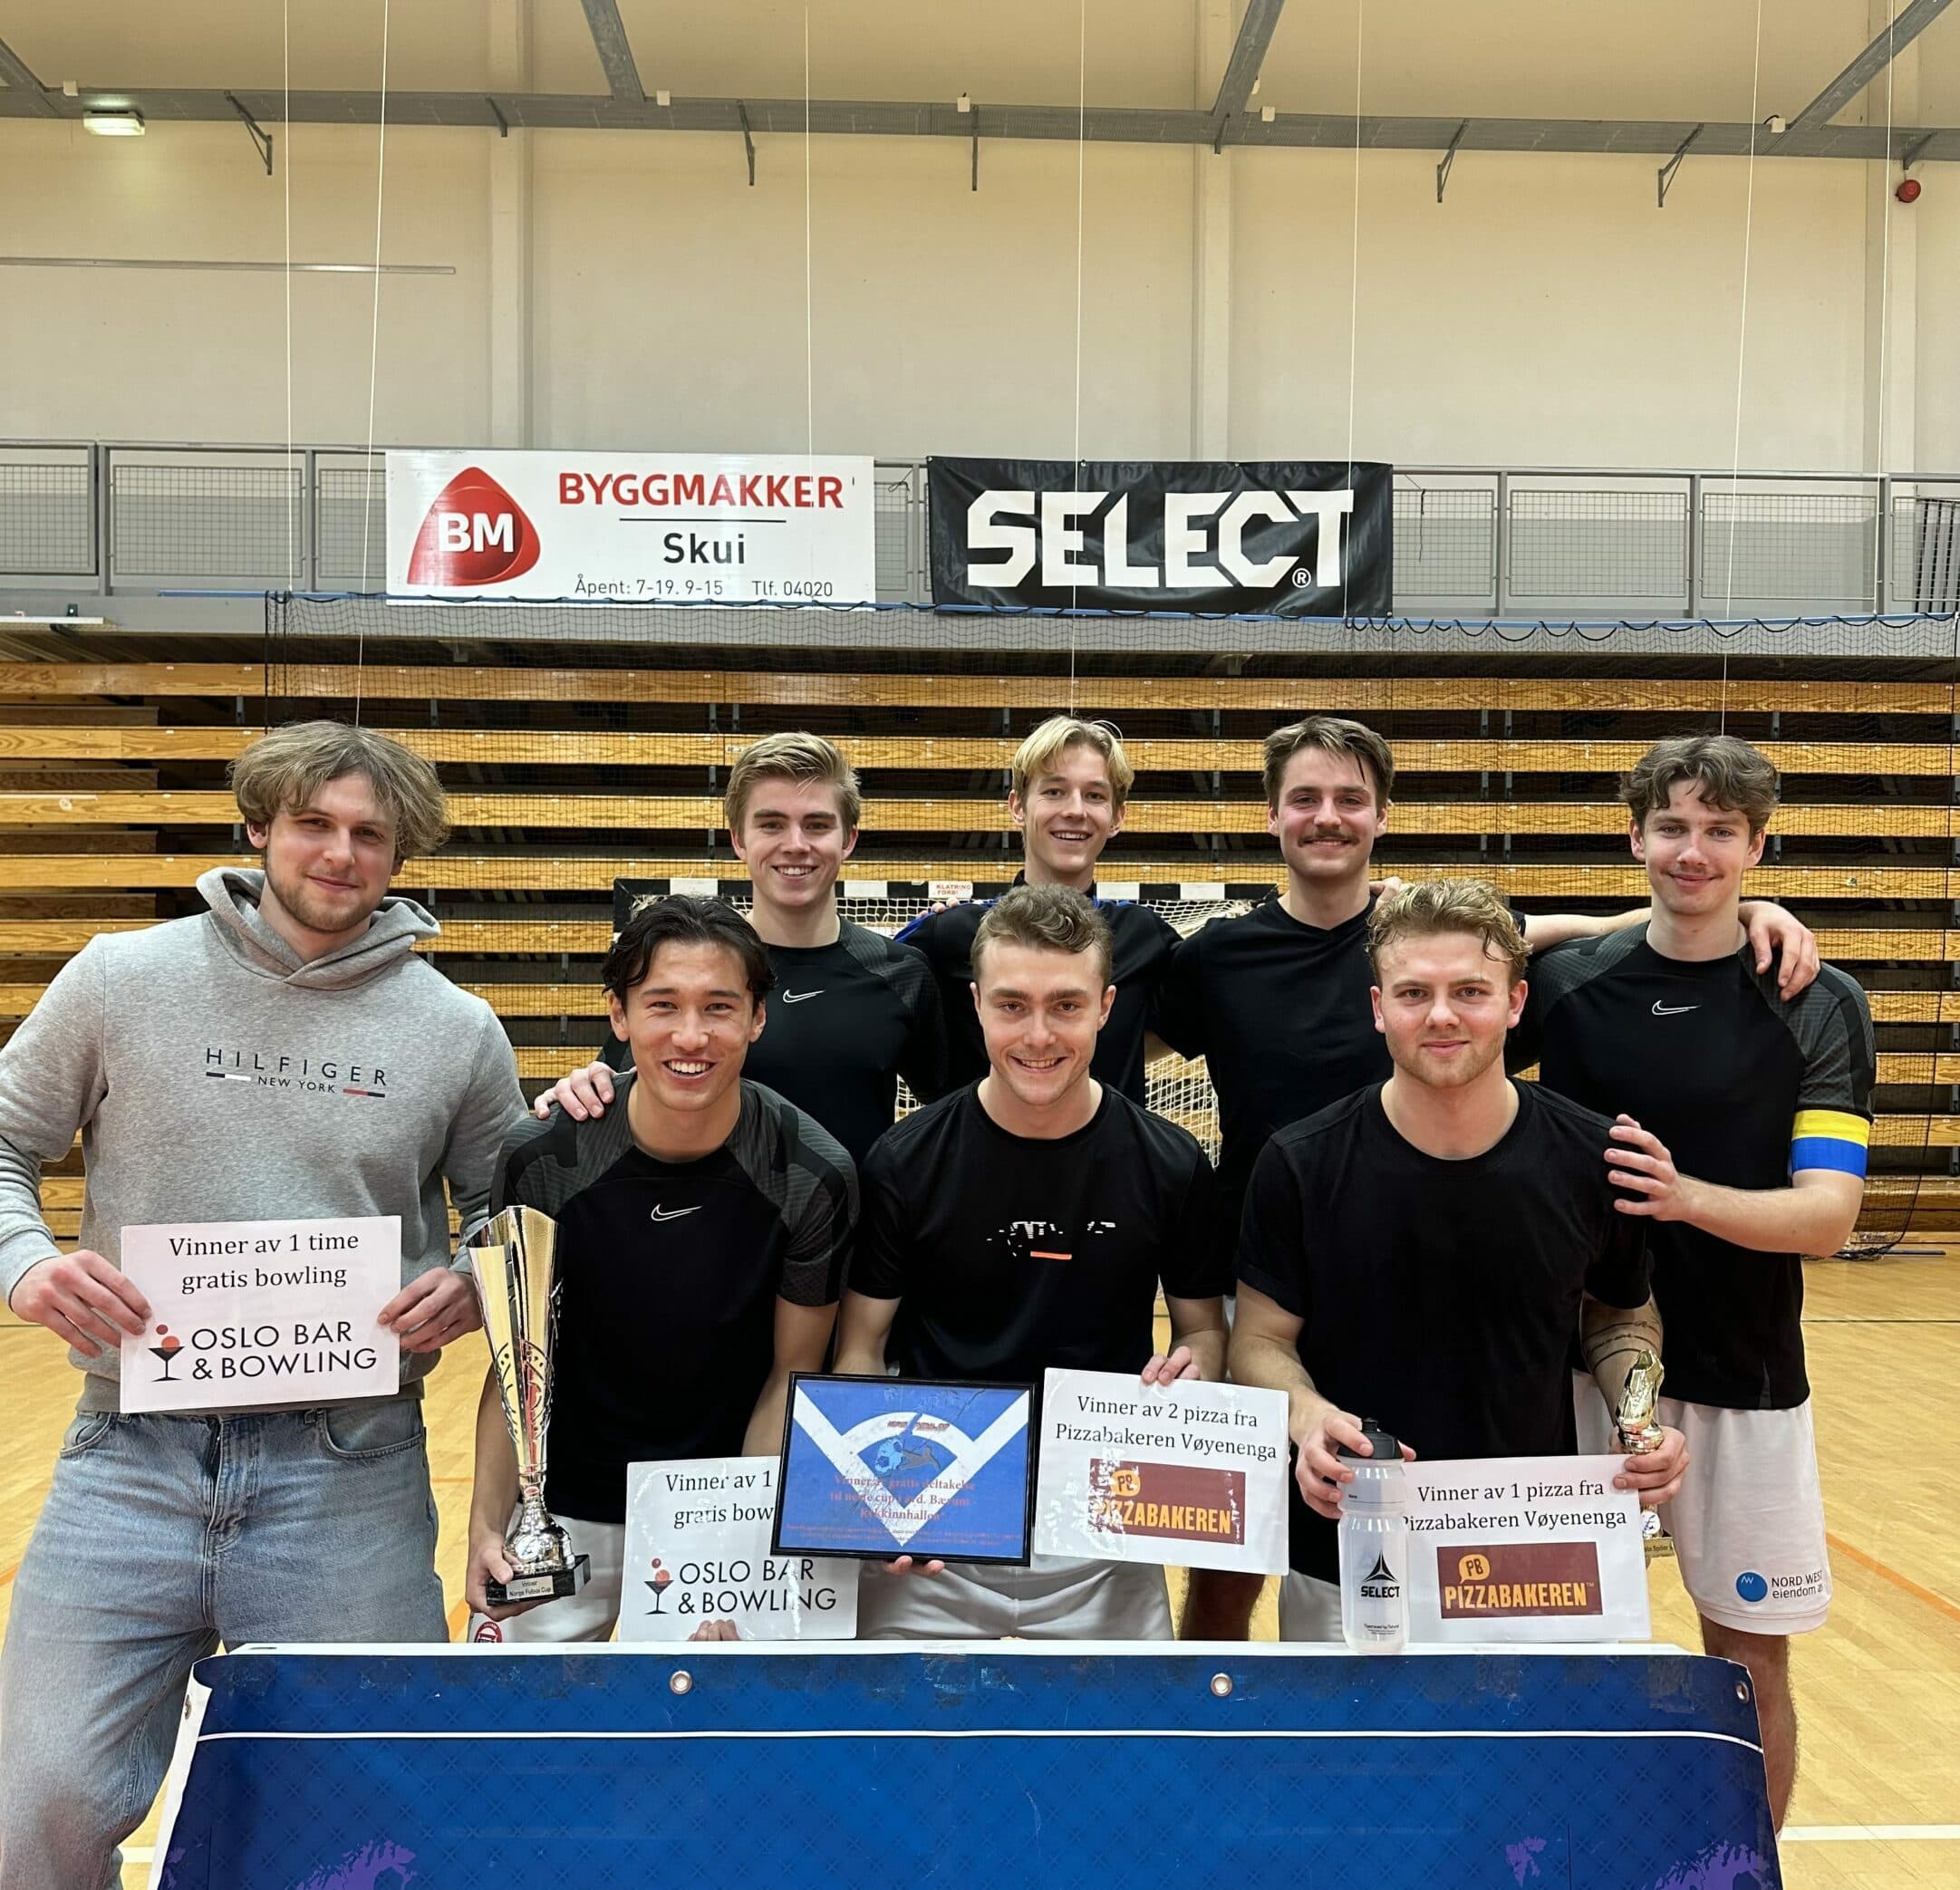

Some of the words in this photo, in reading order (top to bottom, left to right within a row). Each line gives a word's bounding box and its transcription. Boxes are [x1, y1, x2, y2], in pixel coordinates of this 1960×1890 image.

[559, 472, 844, 508] BYGGMAKKER
[438, 513, 515, 553] BM
[967, 489, 1354, 588] SELECT
[663, 532, 745, 564] Skui
[574, 574, 632, 596] Åpent:
[636, 579, 680, 596] 7-19.
[685, 580, 723, 596] 9-15
[752, 580, 777, 596] Tlf.
[783, 581, 834, 597] 04020
[206, 1047, 387, 1086] HILFIGER
[257, 1075, 291, 1087] NEW
[298, 1081, 335, 1094] YORK
[169, 1238, 249, 1257] Vinner
[255, 1240, 282, 1253] av
[289, 1234, 302, 1252] 1
[309, 1232, 359, 1251] time
[181, 1270, 248, 1295] gratis
[255, 1266, 348, 1287] bowling
[191, 1326, 280, 1351] OSLO
[294, 1321, 352, 1345] BAR
[192, 1357, 214, 1380] &
[221, 1348, 378, 1379] BOWLING
[1077, 1395, 1139, 1415] Vinner
[1142, 1405, 1163, 1418] av
[1168, 1403, 1179, 1420] 2
[1183, 1405, 1230, 1425] pizza
[1233, 1410, 1258, 1428] fra
[1056, 1422, 1176, 1449] Pizzabakeren
[1181, 1432, 1277, 1462] Vøyenenga
[665, 1474, 729, 1492] Vinner
[733, 1475, 757, 1489] av
[762, 1470, 772, 1488] 1
[1417, 1486, 1480, 1502] Vinner
[1484, 1487, 1506, 1499] av
[1511, 1483, 1521, 1499] 1
[1527, 1482, 1574, 1502] pizza
[1579, 1480, 1605, 1496] fra
[874, 1494, 893, 1506] cup
[673, 1505, 727, 1529] gratis
[1094, 1499, 1232, 1535] IZZABAKEREN
[1524, 1509, 1627, 1530] Vøyenenga
[679, 1560, 751, 1585] OSLO
[762, 1558, 815, 1581] BAR
[1465, 1557, 1484, 1577] PB
[1772, 1576, 1803, 1588] NORD
[1805, 1569, 1822, 1585] WEST
[678, 1592, 696, 1615] &
[702, 1587, 836, 1614] BOWLING
[1360, 1585, 1400, 1598] SELECT
[1444, 1582, 1588, 1610] PIZZABAKEREN
[1772, 1586, 1816, 1599] eiendom
